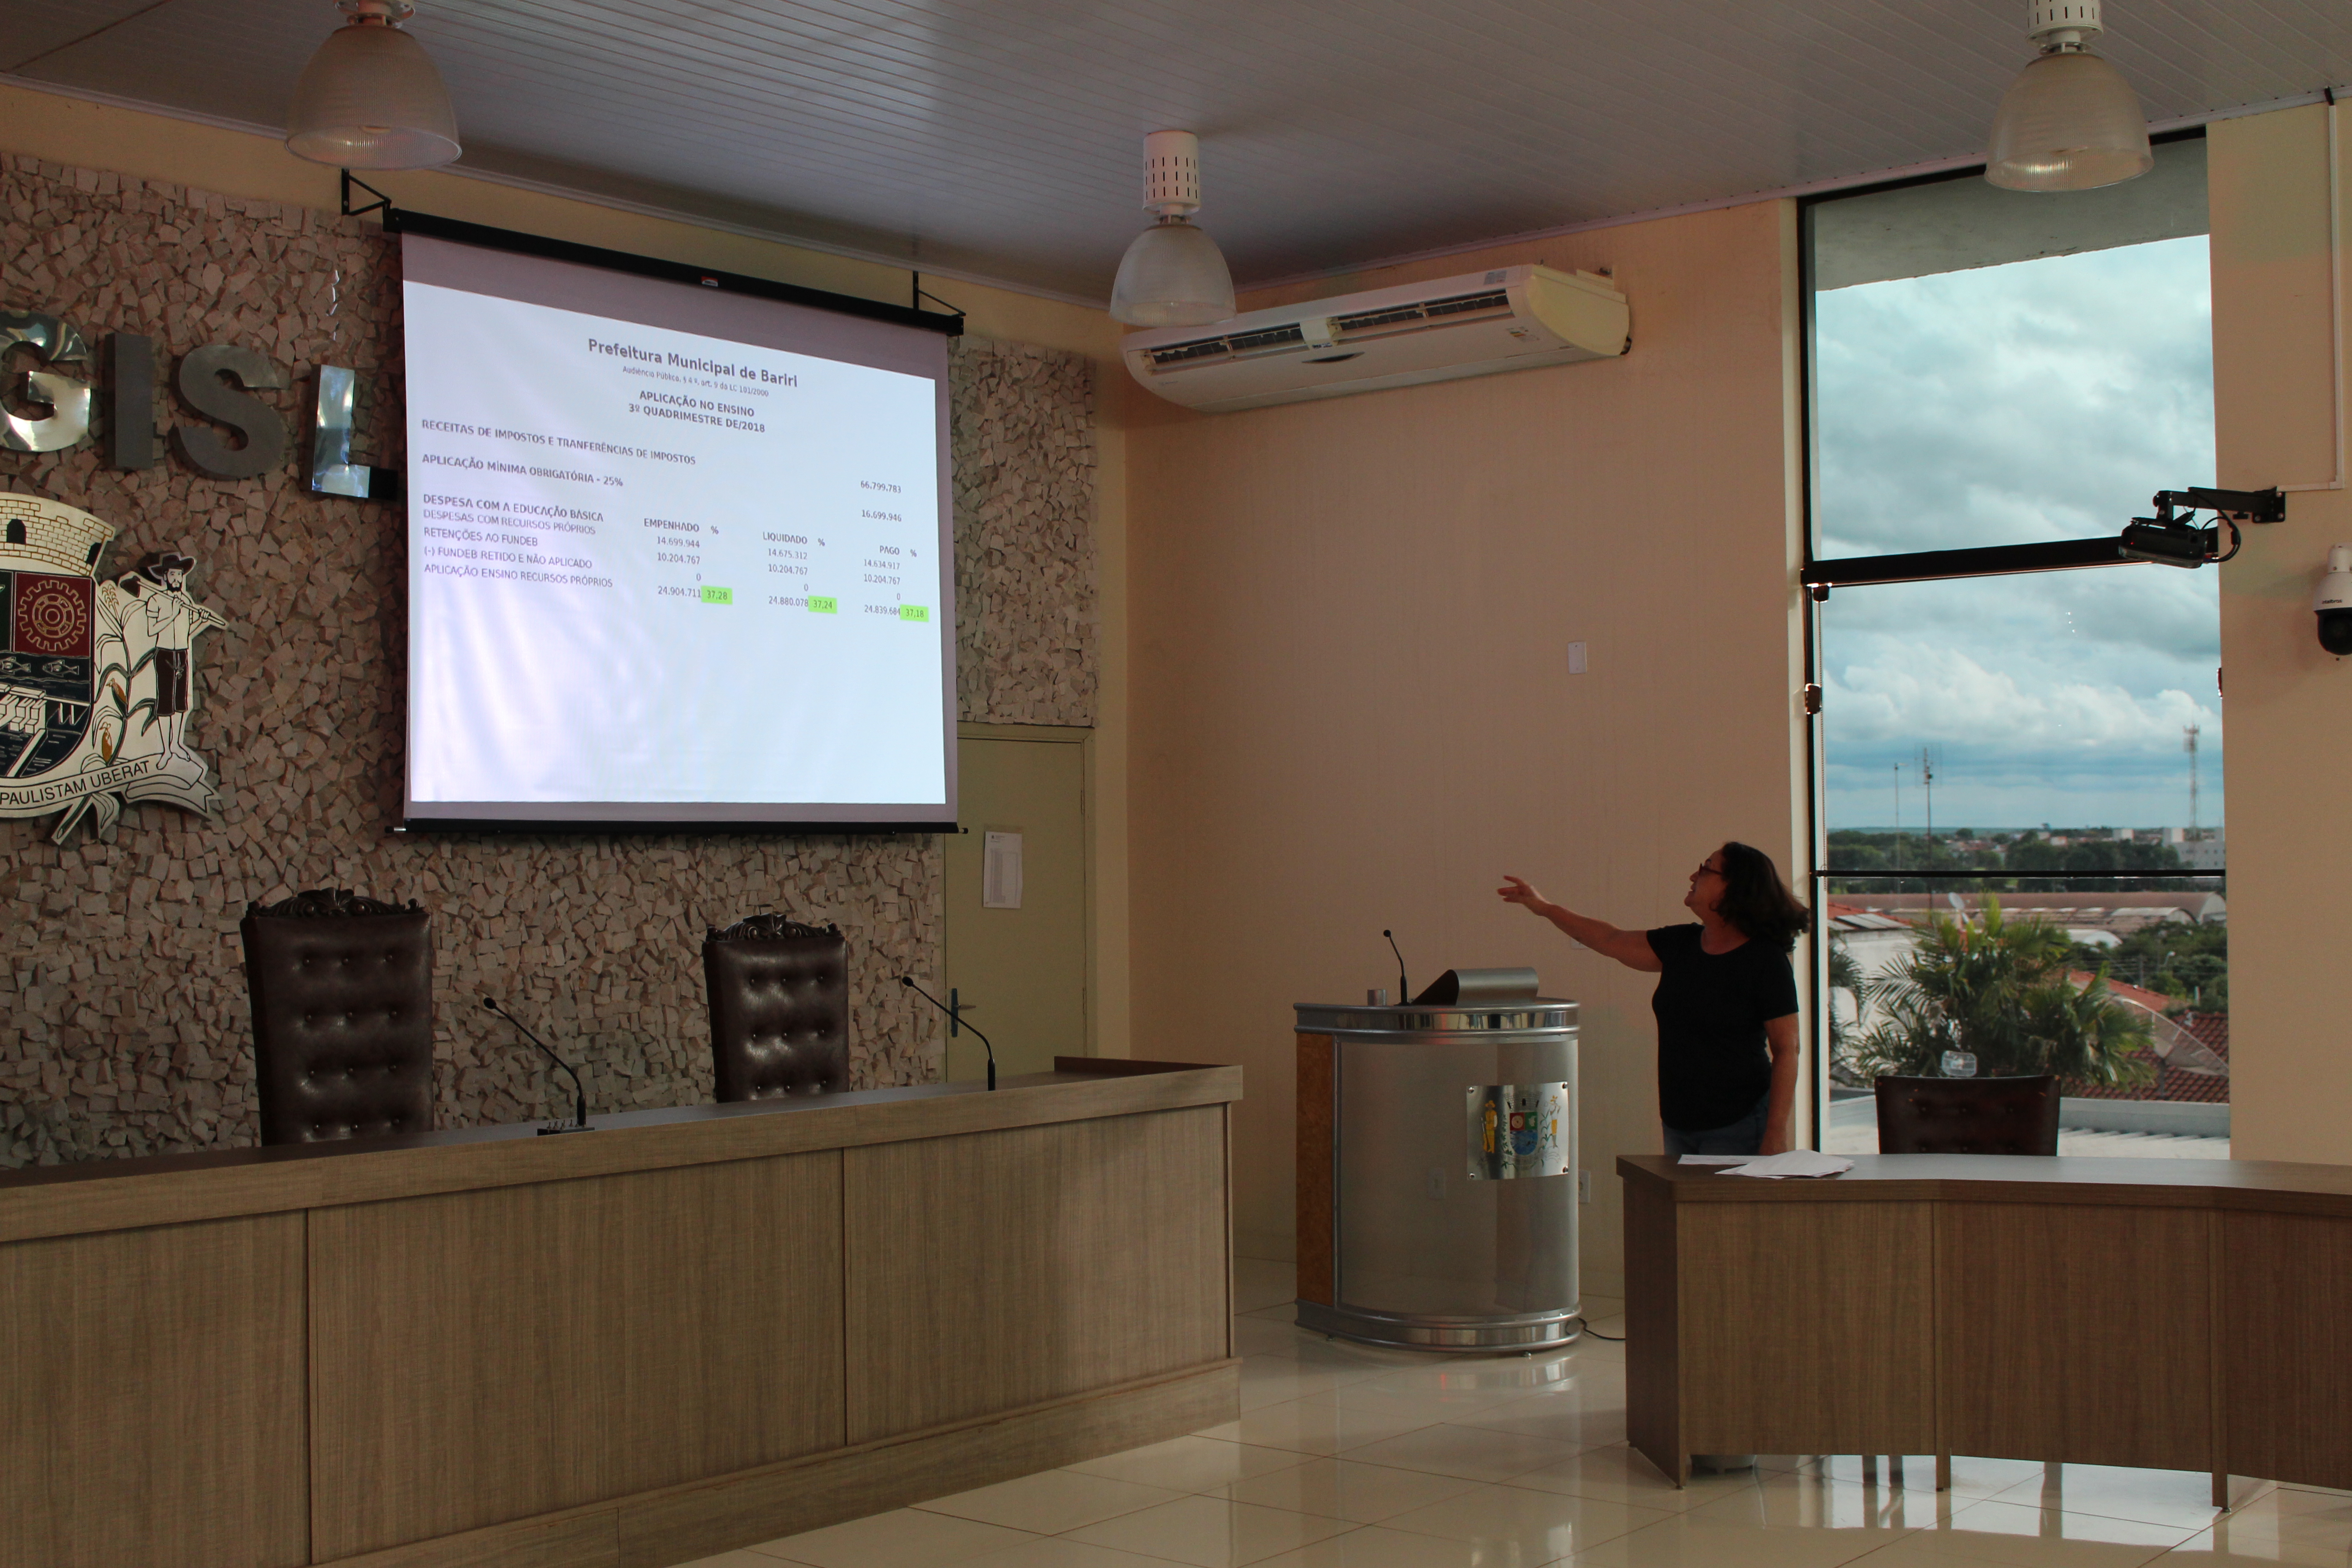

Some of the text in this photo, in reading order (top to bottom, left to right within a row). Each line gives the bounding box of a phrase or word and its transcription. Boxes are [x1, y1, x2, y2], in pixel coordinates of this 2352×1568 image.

[588, 338, 797, 387] Prefeitura Municipal de Bariri
[740, 386, 769, 397] 101/2000
[640, 390, 754, 417] APLICAÇÃO NO ENSINO
[644, 406, 722, 426] QUADRIMESTRE
[726, 418, 765, 432] DE/2018
[422, 420, 696, 465] RECEITAS DE IMPOSTOS E TRANFERÊNCIAS DE IMPOSTOS
[422, 454, 483, 470] APLICAÇÃO
[487, 460, 526, 475] MÍNIMA
[529, 466, 593, 483] OBRIGATÓRIA
[603, 476, 623, 487] 25%
[860, 480, 901, 494] 66.799.783
[423, 494, 603, 522] DESPESA COM A EDUCAÇÃO BÁSICA
[423, 509, 596, 534] DESPESAS COM RECURSOS PRÓPRIOS
[862, 510, 902, 522] 16.699.946
[644, 518, 719, 534] EMPENHADO %
[424, 527, 538, 546] RETENÇÕES AO FUNDEB
[657, 536, 700, 549] 14.699.944
[763, 532, 825, 547] LIQUIDADO %
[438, 548, 478, 559] FUNDEB
[481, 551, 515, 563] RETIDO
[518, 554, 524, 563] E
[526, 554, 545, 565] NÃO
[549, 556, 592, 569] APLICADO
[657, 552, 700, 565] 10.204.767
[879, 545, 917, 557] PAGO %
[424, 564, 613, 588] APLICAÇÃO ENSINO RECURSOS PRÓPRIOS
[696, 573, 701, 581] 0
[768, 564, 808, 575] 10.204.767
[864, 574, 900, 585] 10.204.767
[658, 586, 701, 598] 24.904.711
[804, 583, 808, 592] 0
[769, 596, 808, 607] 24.880.078
[0, 760, 149, 805] PAULISTAM UBERAT
